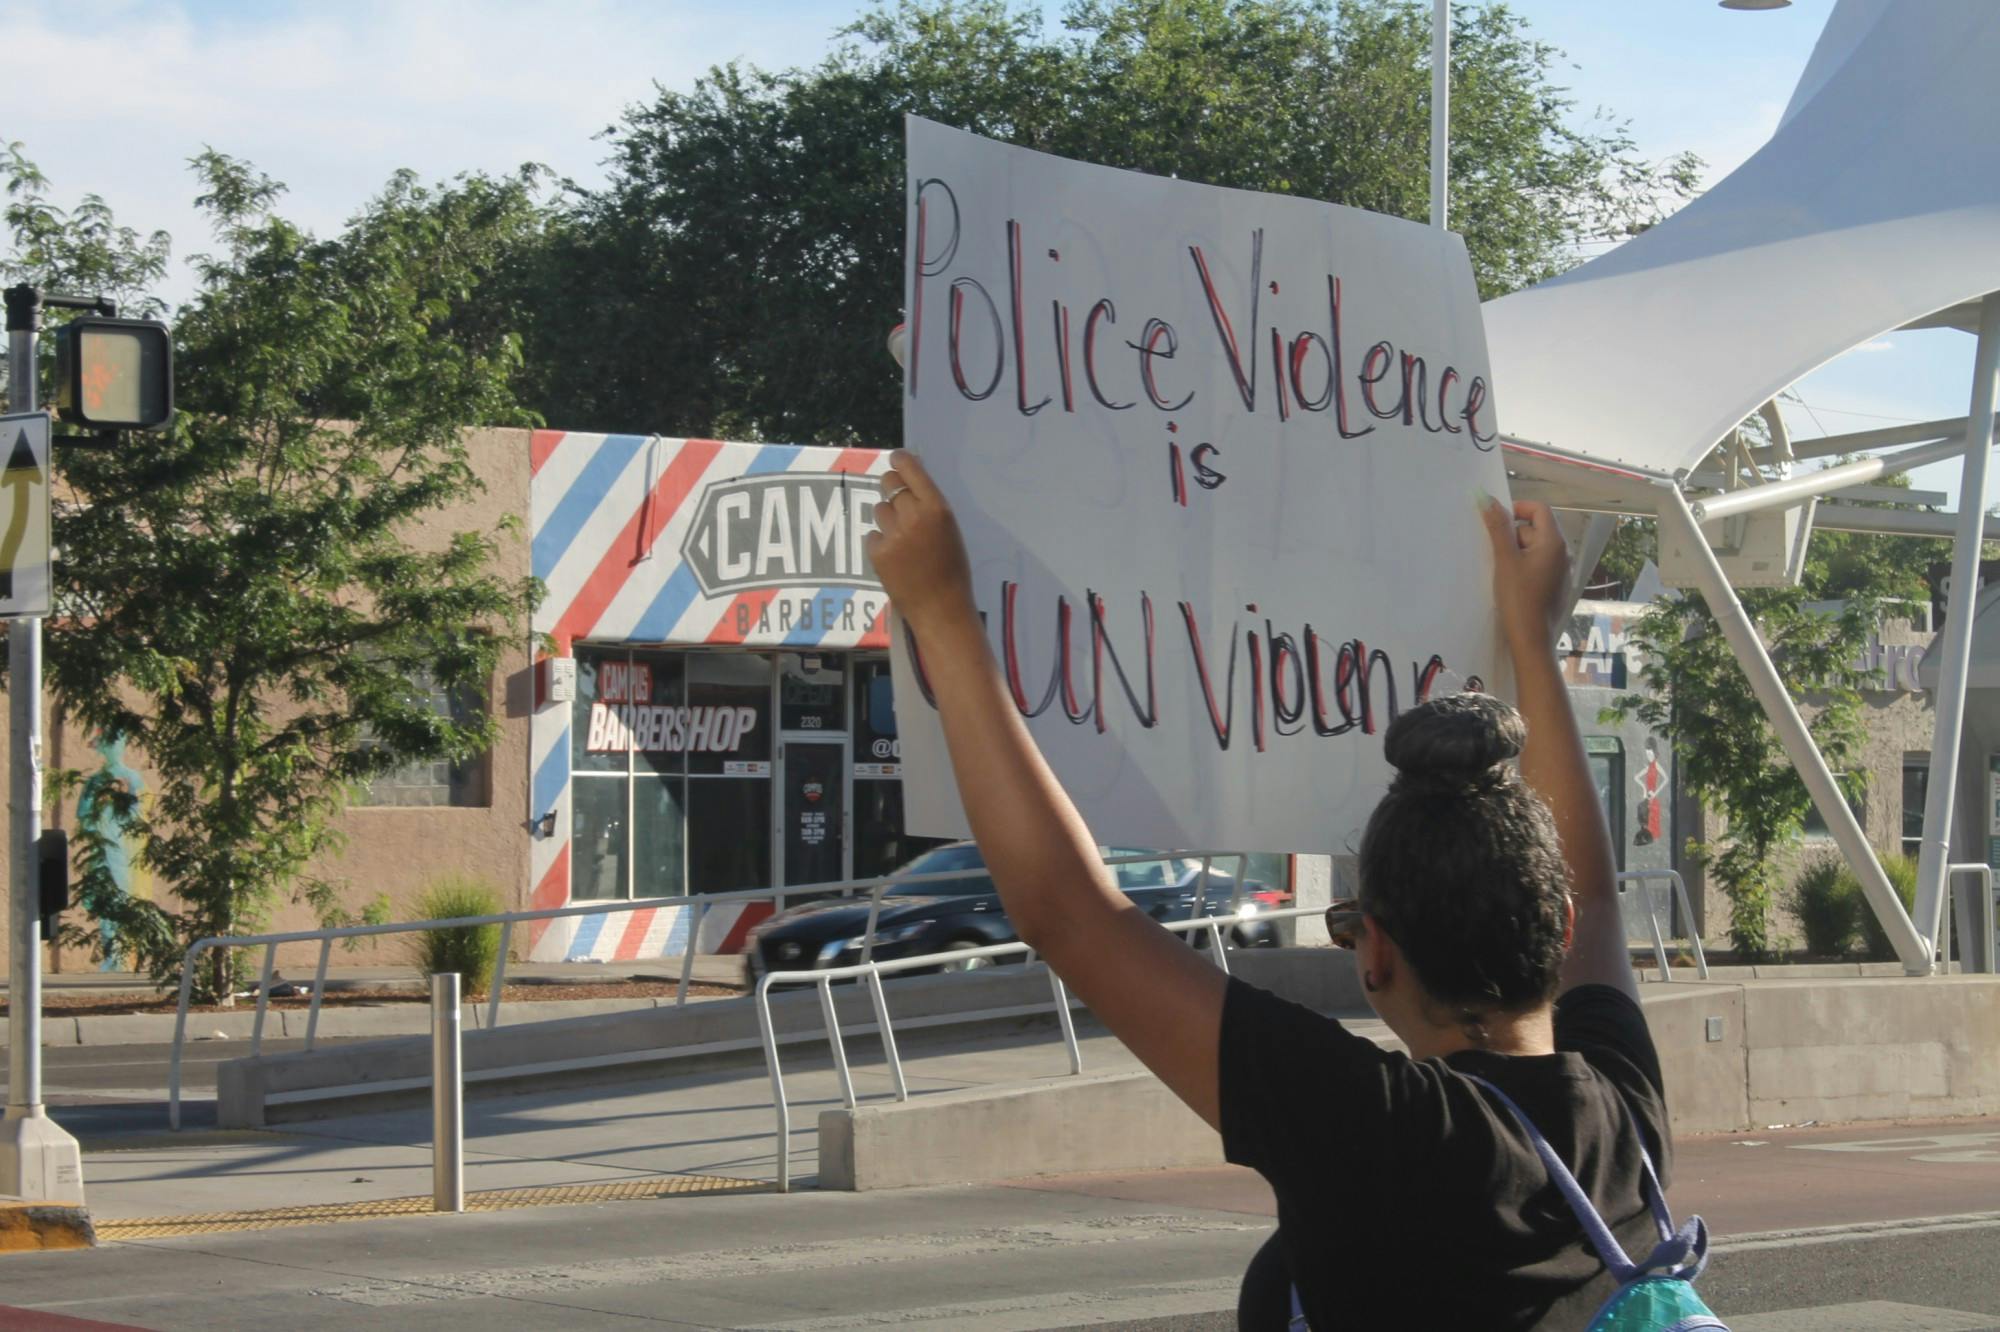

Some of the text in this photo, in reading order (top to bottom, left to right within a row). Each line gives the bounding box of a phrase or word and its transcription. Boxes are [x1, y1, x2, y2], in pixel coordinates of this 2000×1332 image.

[911, 178, 1496, 452] Police Violence
[1167, 421, 1226, 507] is
[736, 599, 890, 637] BARBERS
[602, 663, 649, 701] CAMPUS
[586, 702, 757, 752] BARBERSHOP
